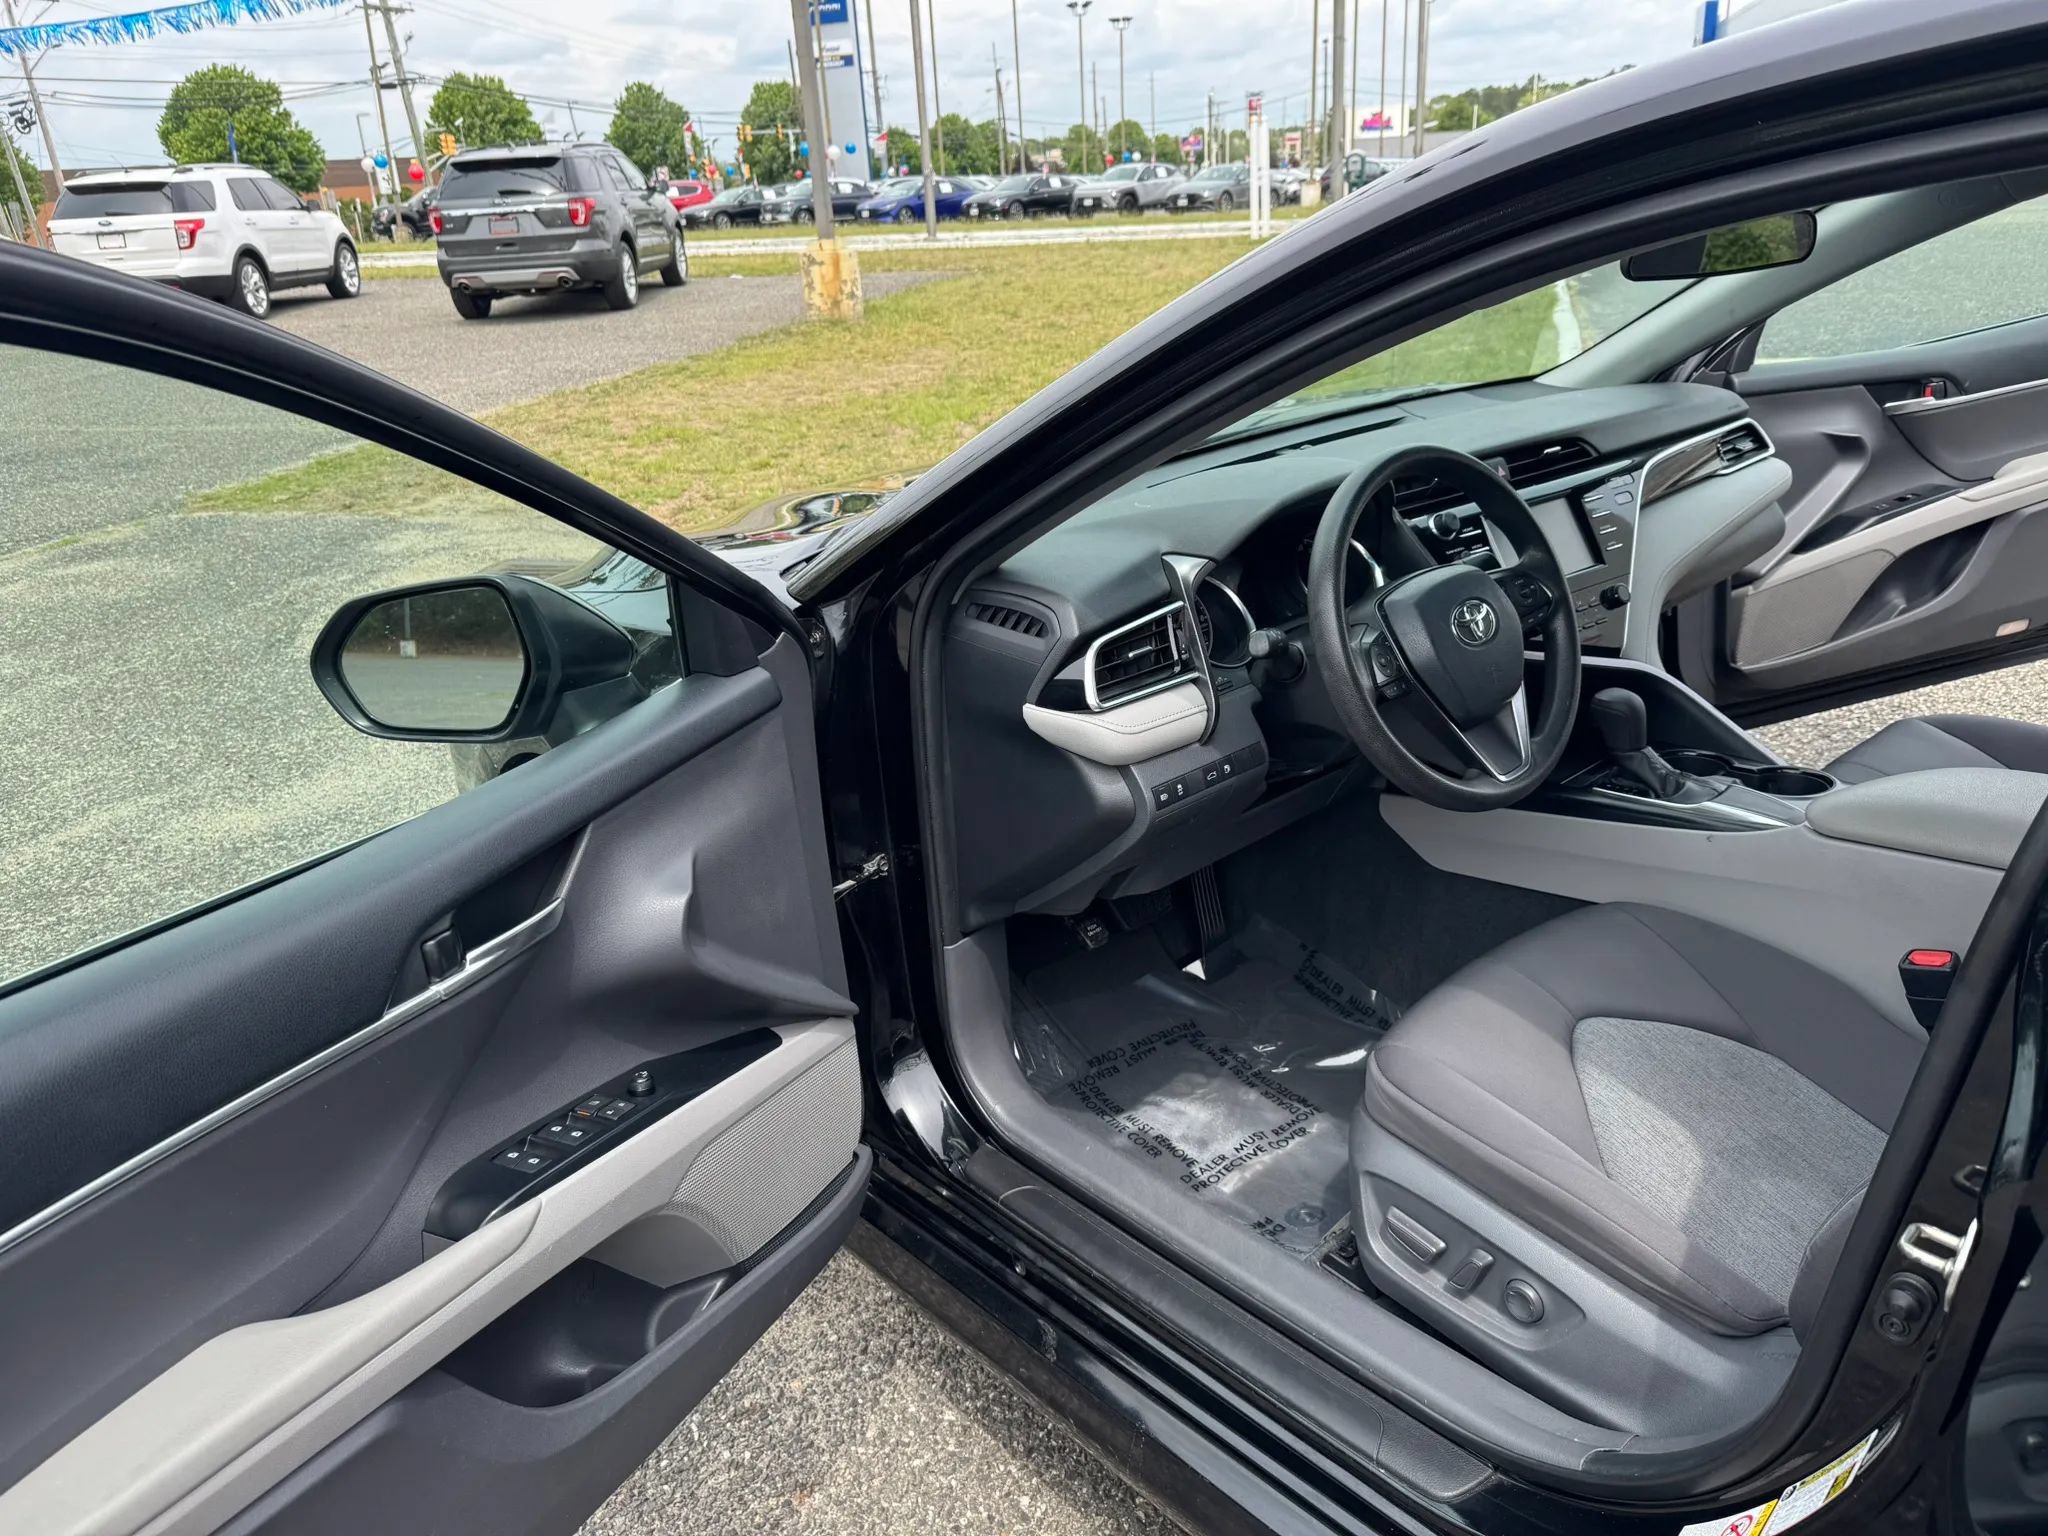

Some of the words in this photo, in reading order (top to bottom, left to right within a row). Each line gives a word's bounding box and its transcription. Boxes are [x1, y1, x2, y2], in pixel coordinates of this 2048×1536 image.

[1075, 1089, 1130, 1134] PROTECTIVE
[1127, 1132, 1162, 1159] COVER
[1089, 1086, 1125, 1115] DEALER
[1123, 1114, 1154, 1134] MUST
[1152, 1133, 1200, 1168] REMOVE
[1180, 1153, 1229, 1184] DEALER
[1233, 1130, 1269, 1154] MUST
[1271, 1106, 1322, 1137] REMOVE
[1191, 1144, 1266, 1192] PROTECTIVE
[1268, 1126, 1310, 1150] COVER
